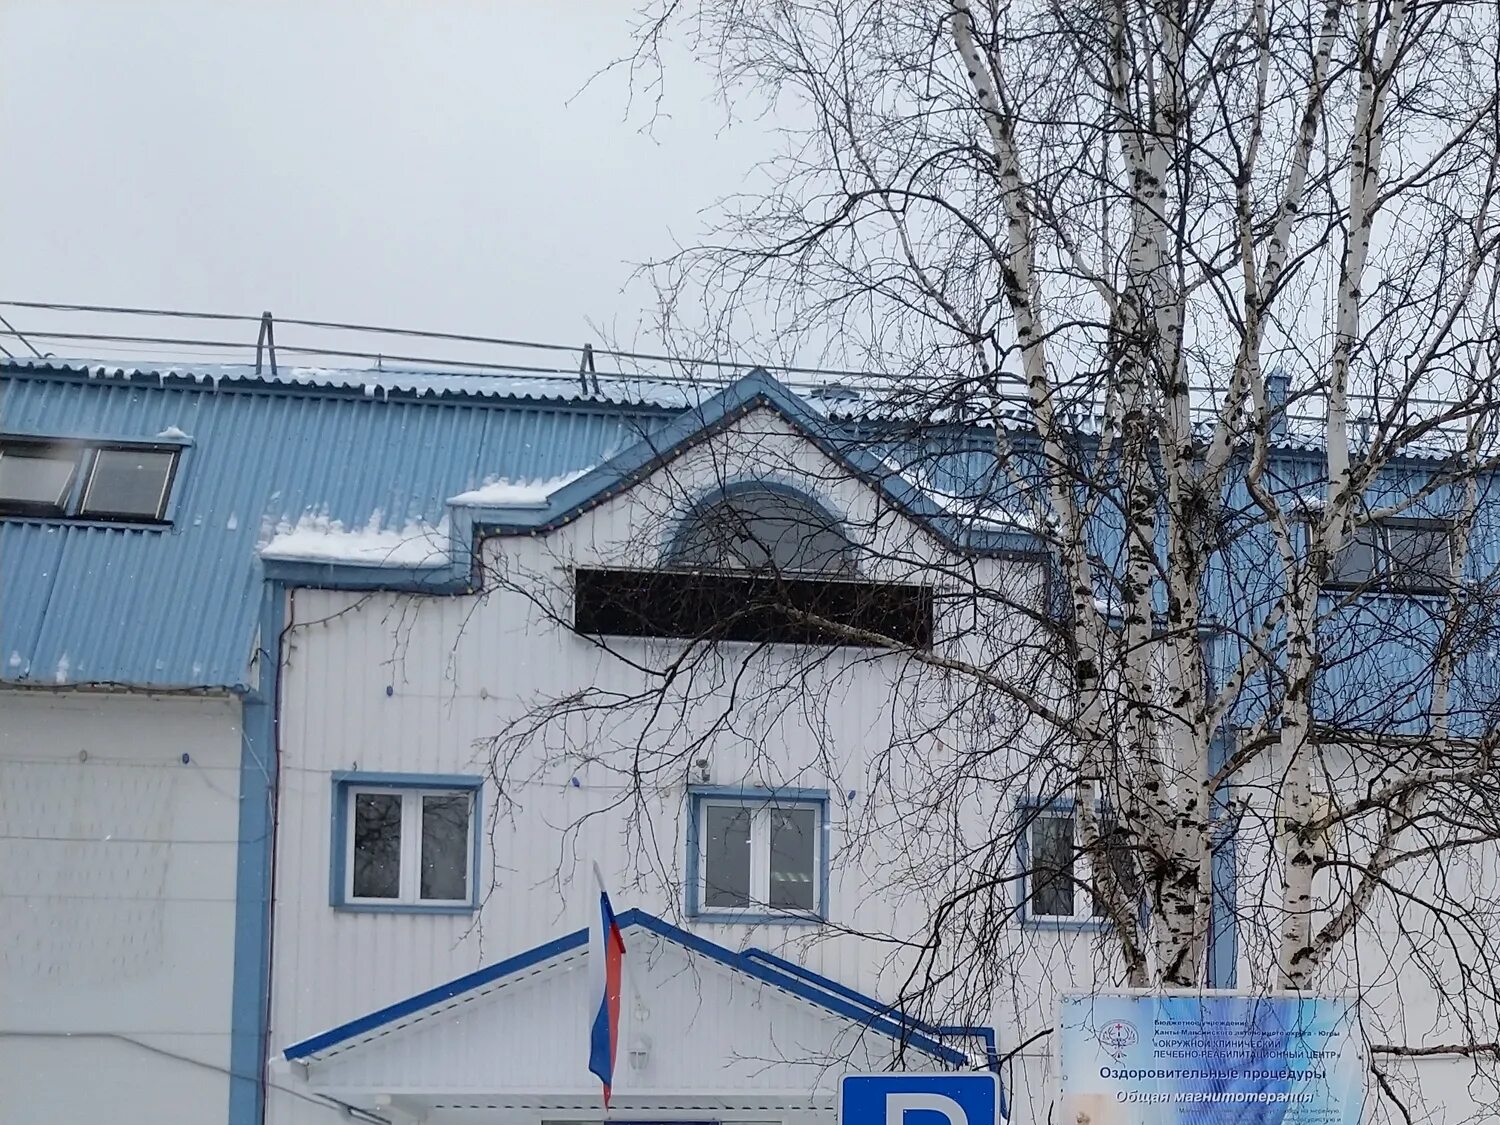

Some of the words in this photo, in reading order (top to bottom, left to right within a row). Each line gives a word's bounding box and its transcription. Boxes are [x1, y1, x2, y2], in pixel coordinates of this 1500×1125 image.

[1213, 1040, 1281, 1048] КЛИНИЧЕСКИЙ
[1153, 1051, 1304, 1059] ЛЕЧЕБНО-РЕАБИЛИТАЦИОННЫЙ
[1100, 1067, 1238, 1081] Оздоровительные
[1243, 1069, 1326, 1082] процедуры
[1116, 1090, 1170, 1104] Общая
[1174, 1091, 1314, 1104] магнитотерапия
